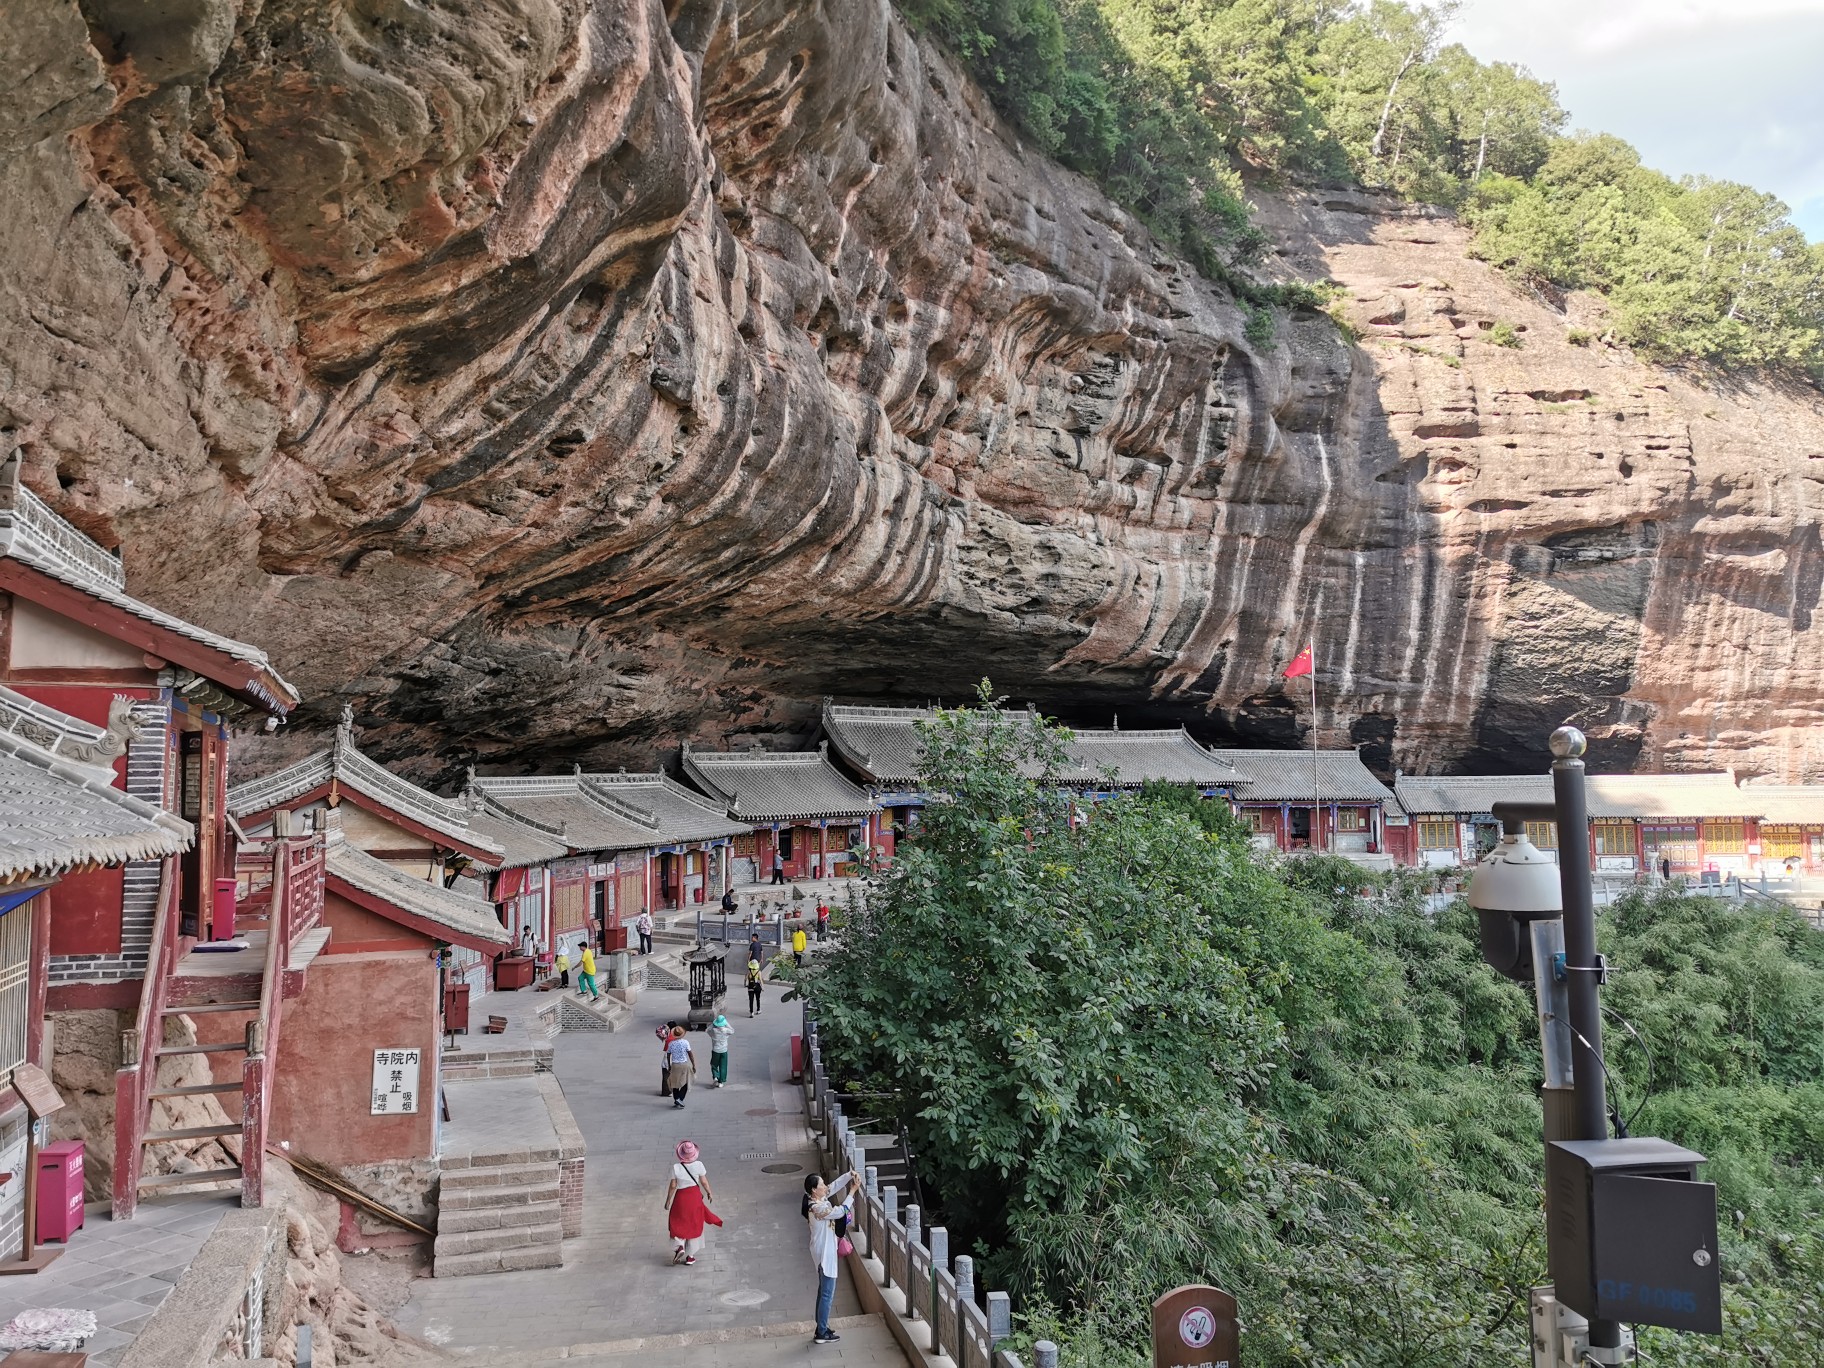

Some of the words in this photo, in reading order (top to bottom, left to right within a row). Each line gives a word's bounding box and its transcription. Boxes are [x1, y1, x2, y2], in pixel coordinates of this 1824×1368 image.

[376, 1052, 418, 1066] 寺院内
[390, 1069, 403, 1093] 禁止
[402, 1091, 412, 1111] 吸烟
